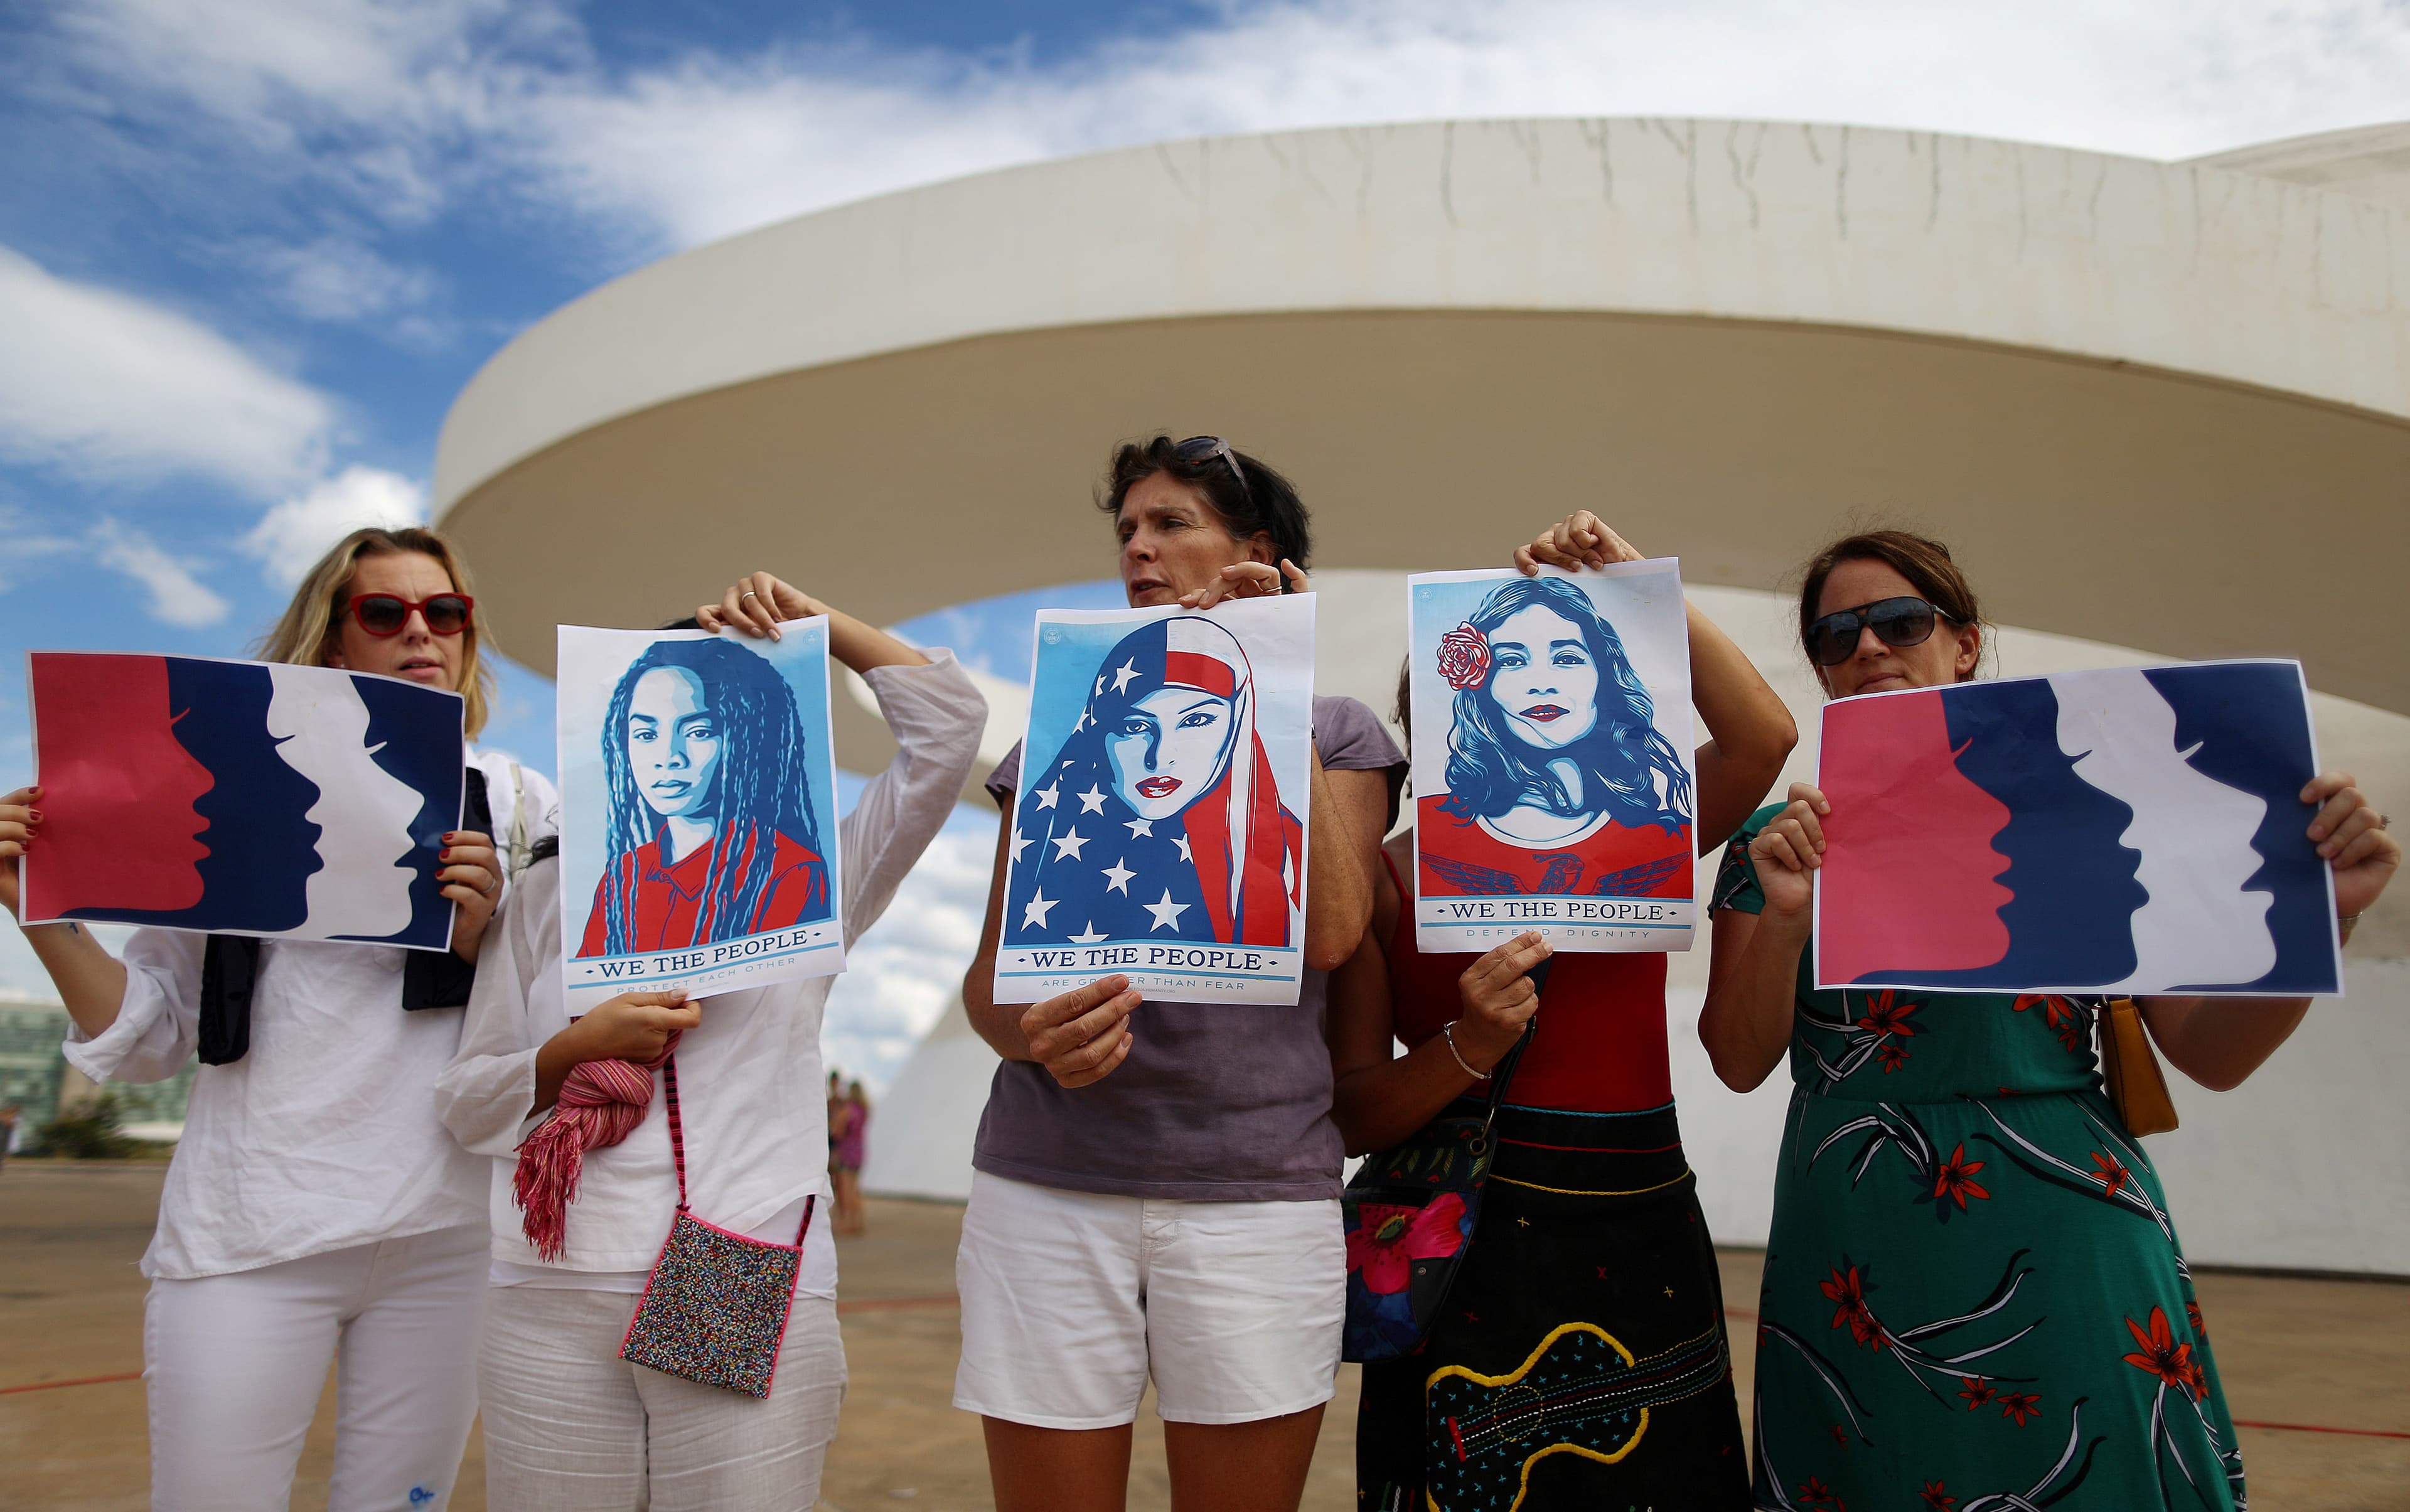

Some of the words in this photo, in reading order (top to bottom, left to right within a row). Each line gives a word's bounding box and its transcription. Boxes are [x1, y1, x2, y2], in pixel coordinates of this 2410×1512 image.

[1450, 903, 1495, 918] WE
[1504, 902, 1558, 918] THE
[1567, 903, 1664, 920] PEOPLE
[1567, 930, 1650, 938] DIGNITY
[598, 960, 645, 979] WE
[653, 952, 705, 973] THE
[714, 930, 808, 963] PEOPLE
[1031, 952, 1076, 967] WE
[1084, 948, 1138, 966] THE
[1149, 948, 1262, 970] PEOPLE
[699, 970, 736, 984] EACH
[745, 958, 796, 972] OTHER
[1042, 979, 1069, 987] ARE
[1078, 977, 1145, 986] GRER
[1154, 977, 1197, 987] THAN
[1205, 982, 1245, 990] FEAR
